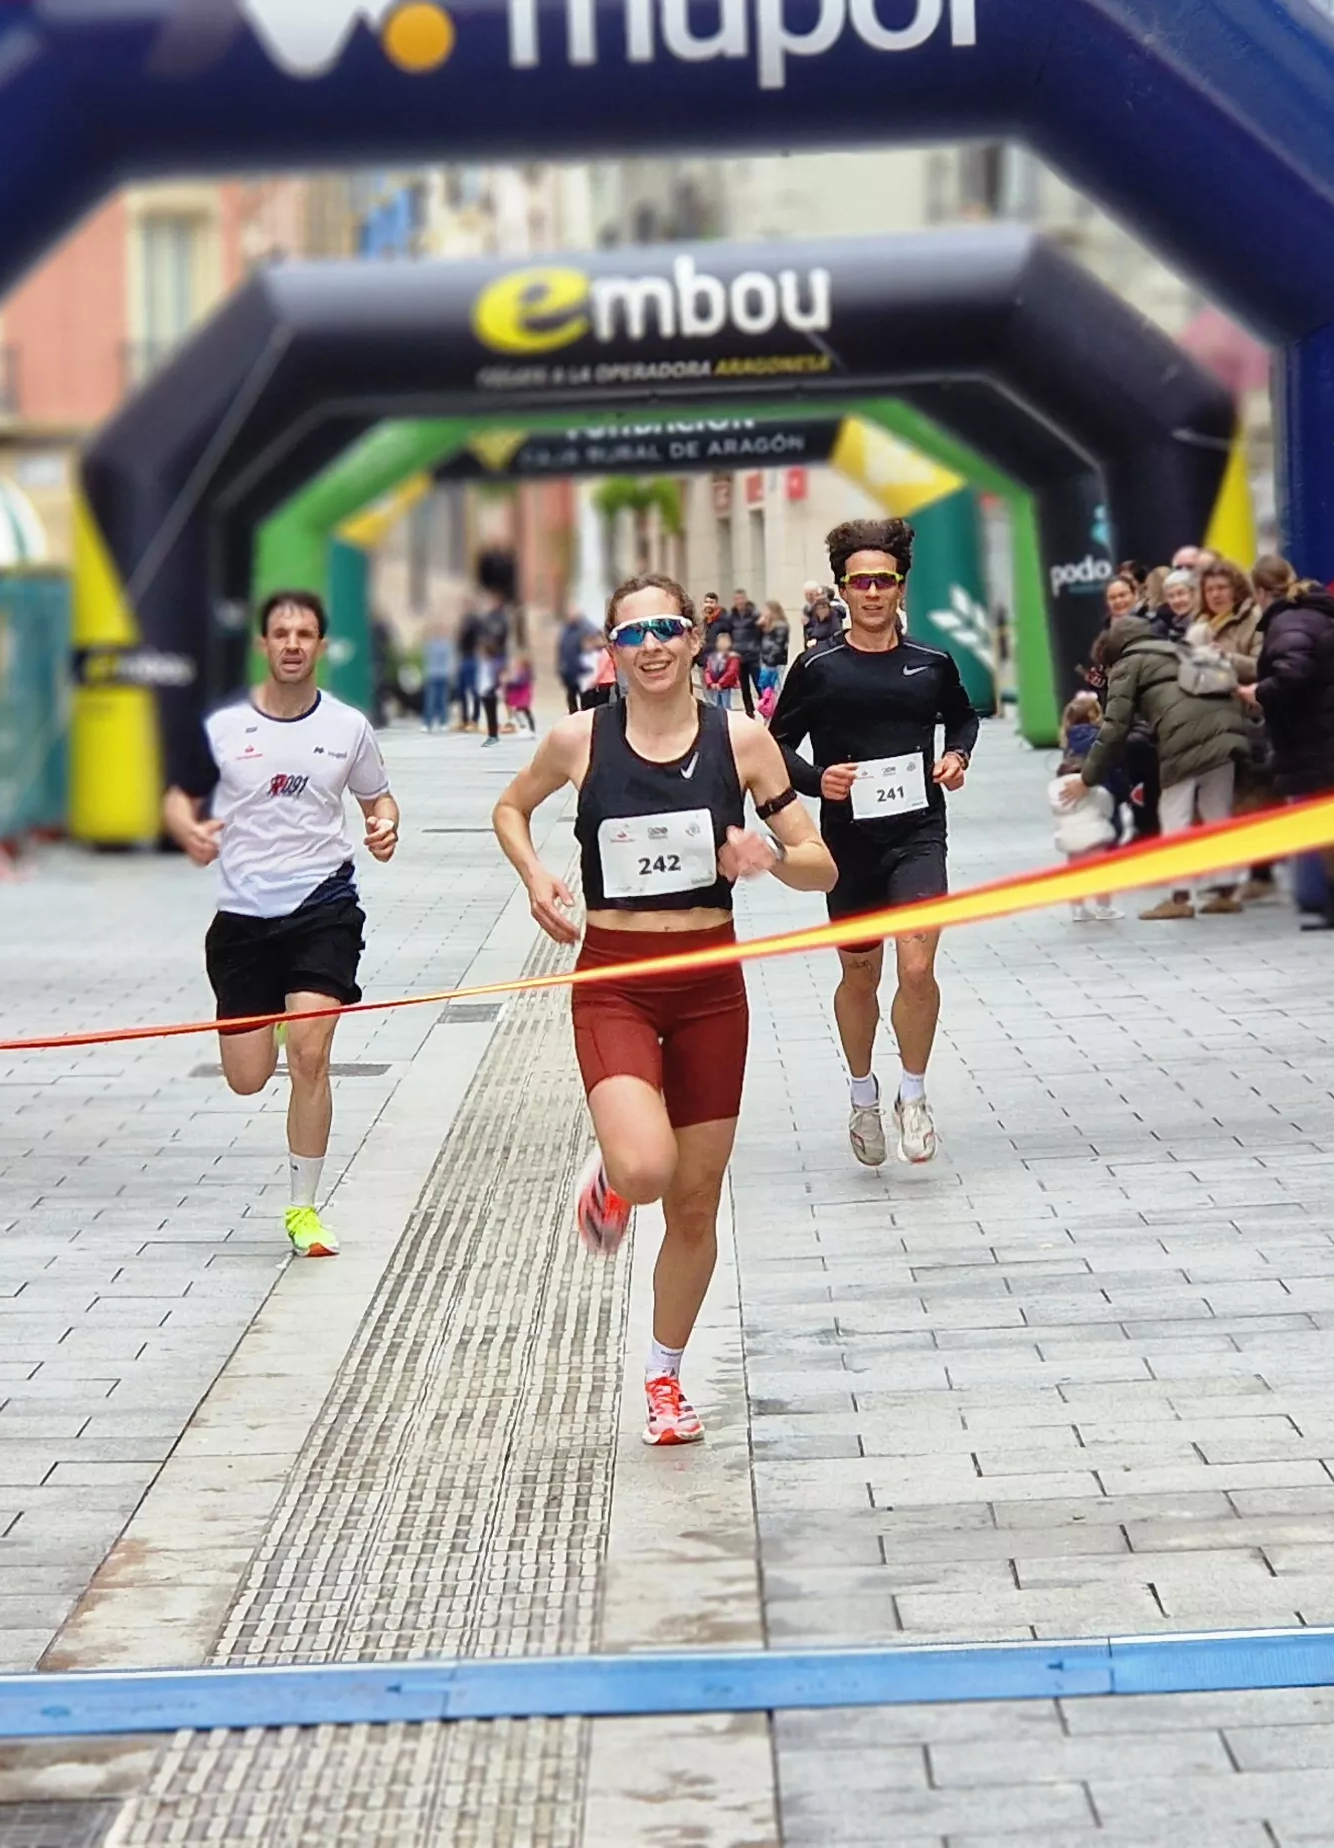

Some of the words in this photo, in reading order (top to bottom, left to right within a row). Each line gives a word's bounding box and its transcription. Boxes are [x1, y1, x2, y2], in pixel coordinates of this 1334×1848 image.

[470, 254, 832, 354] embou
[670, 440, 701, 460] DE
[706, 433, 805, 457] ARAGÓN
[1050, 554, 1113, 598] podo
[876, 785, 905, 803] 241
[638, 854, 682, 876] 242
